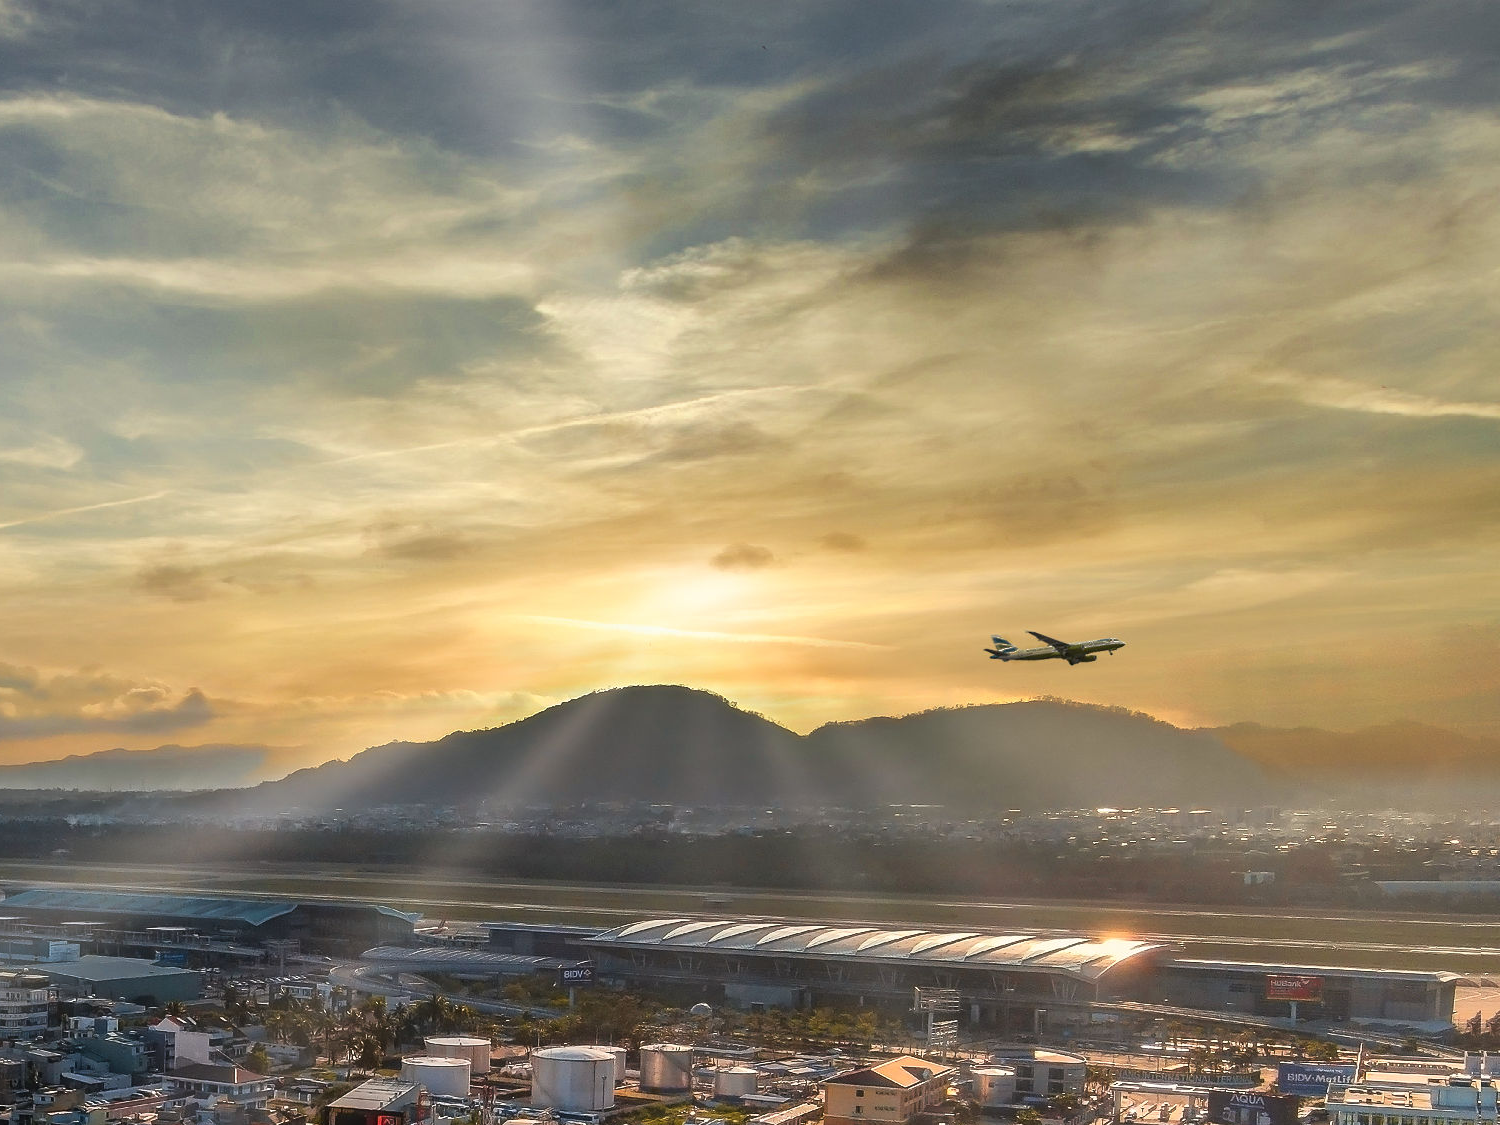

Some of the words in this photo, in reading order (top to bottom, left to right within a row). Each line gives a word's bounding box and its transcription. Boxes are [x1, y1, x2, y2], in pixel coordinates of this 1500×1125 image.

[563, 970, 584, 979] BIDV
[1142, 1071, 1214, 1083] INTERNATIONAL
[1287, 1073, 1314, 1082] BIDV
